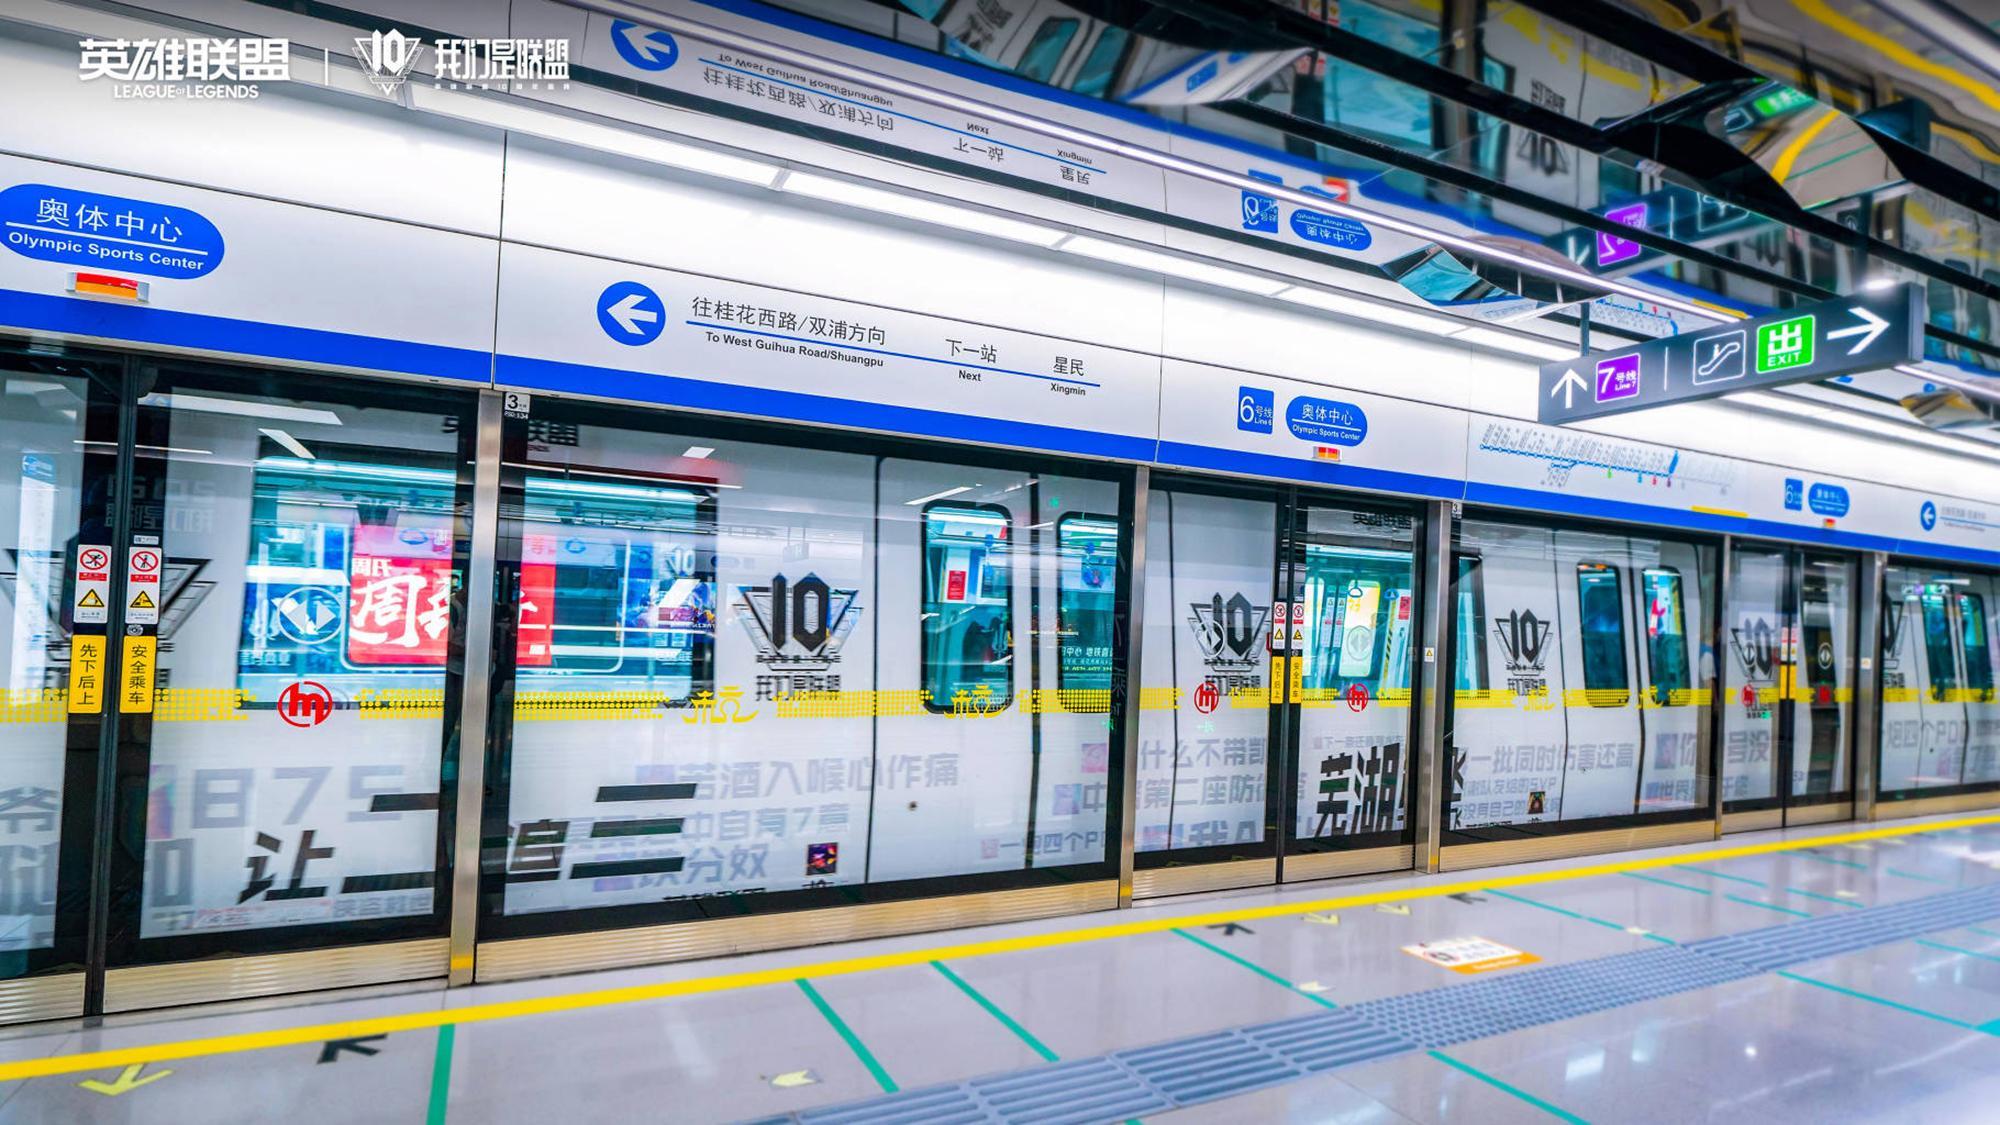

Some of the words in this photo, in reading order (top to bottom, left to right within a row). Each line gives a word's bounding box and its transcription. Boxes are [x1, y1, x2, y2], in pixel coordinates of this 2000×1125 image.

[35, 197, 183, 243] 奥体中心
[8, 231, 83, 254] Olympic
[88, 243, 144, 262] Sports
[149, 253, 205, 271] Center
[691, 296, 886, 346] 往桂花西路/双浦方向
[706, 331, 720, 343] To
[723, 333, 752, 348] West
[755, 339, 796, 354] Guihua
[799, 345, 884, 368] Road/Shuangpu
[945, 338, 998, 363] 下一站
[1767, 324, 1803, 355] 出
[1053, 356, 1085, 377] 星民
[1767, 352, 1802, 367] EXIT
[958, 370, 982, 382] Next
[507, 394, 519, 409] 3
[1050, 382, 1086, 396] Xingmin
[1301, 403, 1353, 426] 奥体中心
[1293, 424, 1318, 435] Olympic
[1319, 428, 1339, 438] Sports
[1340, 431, 1361, 441] Center
[77, 643, 98, 706] 先下后上
[128, 644, 148, 705] 安全乘车
